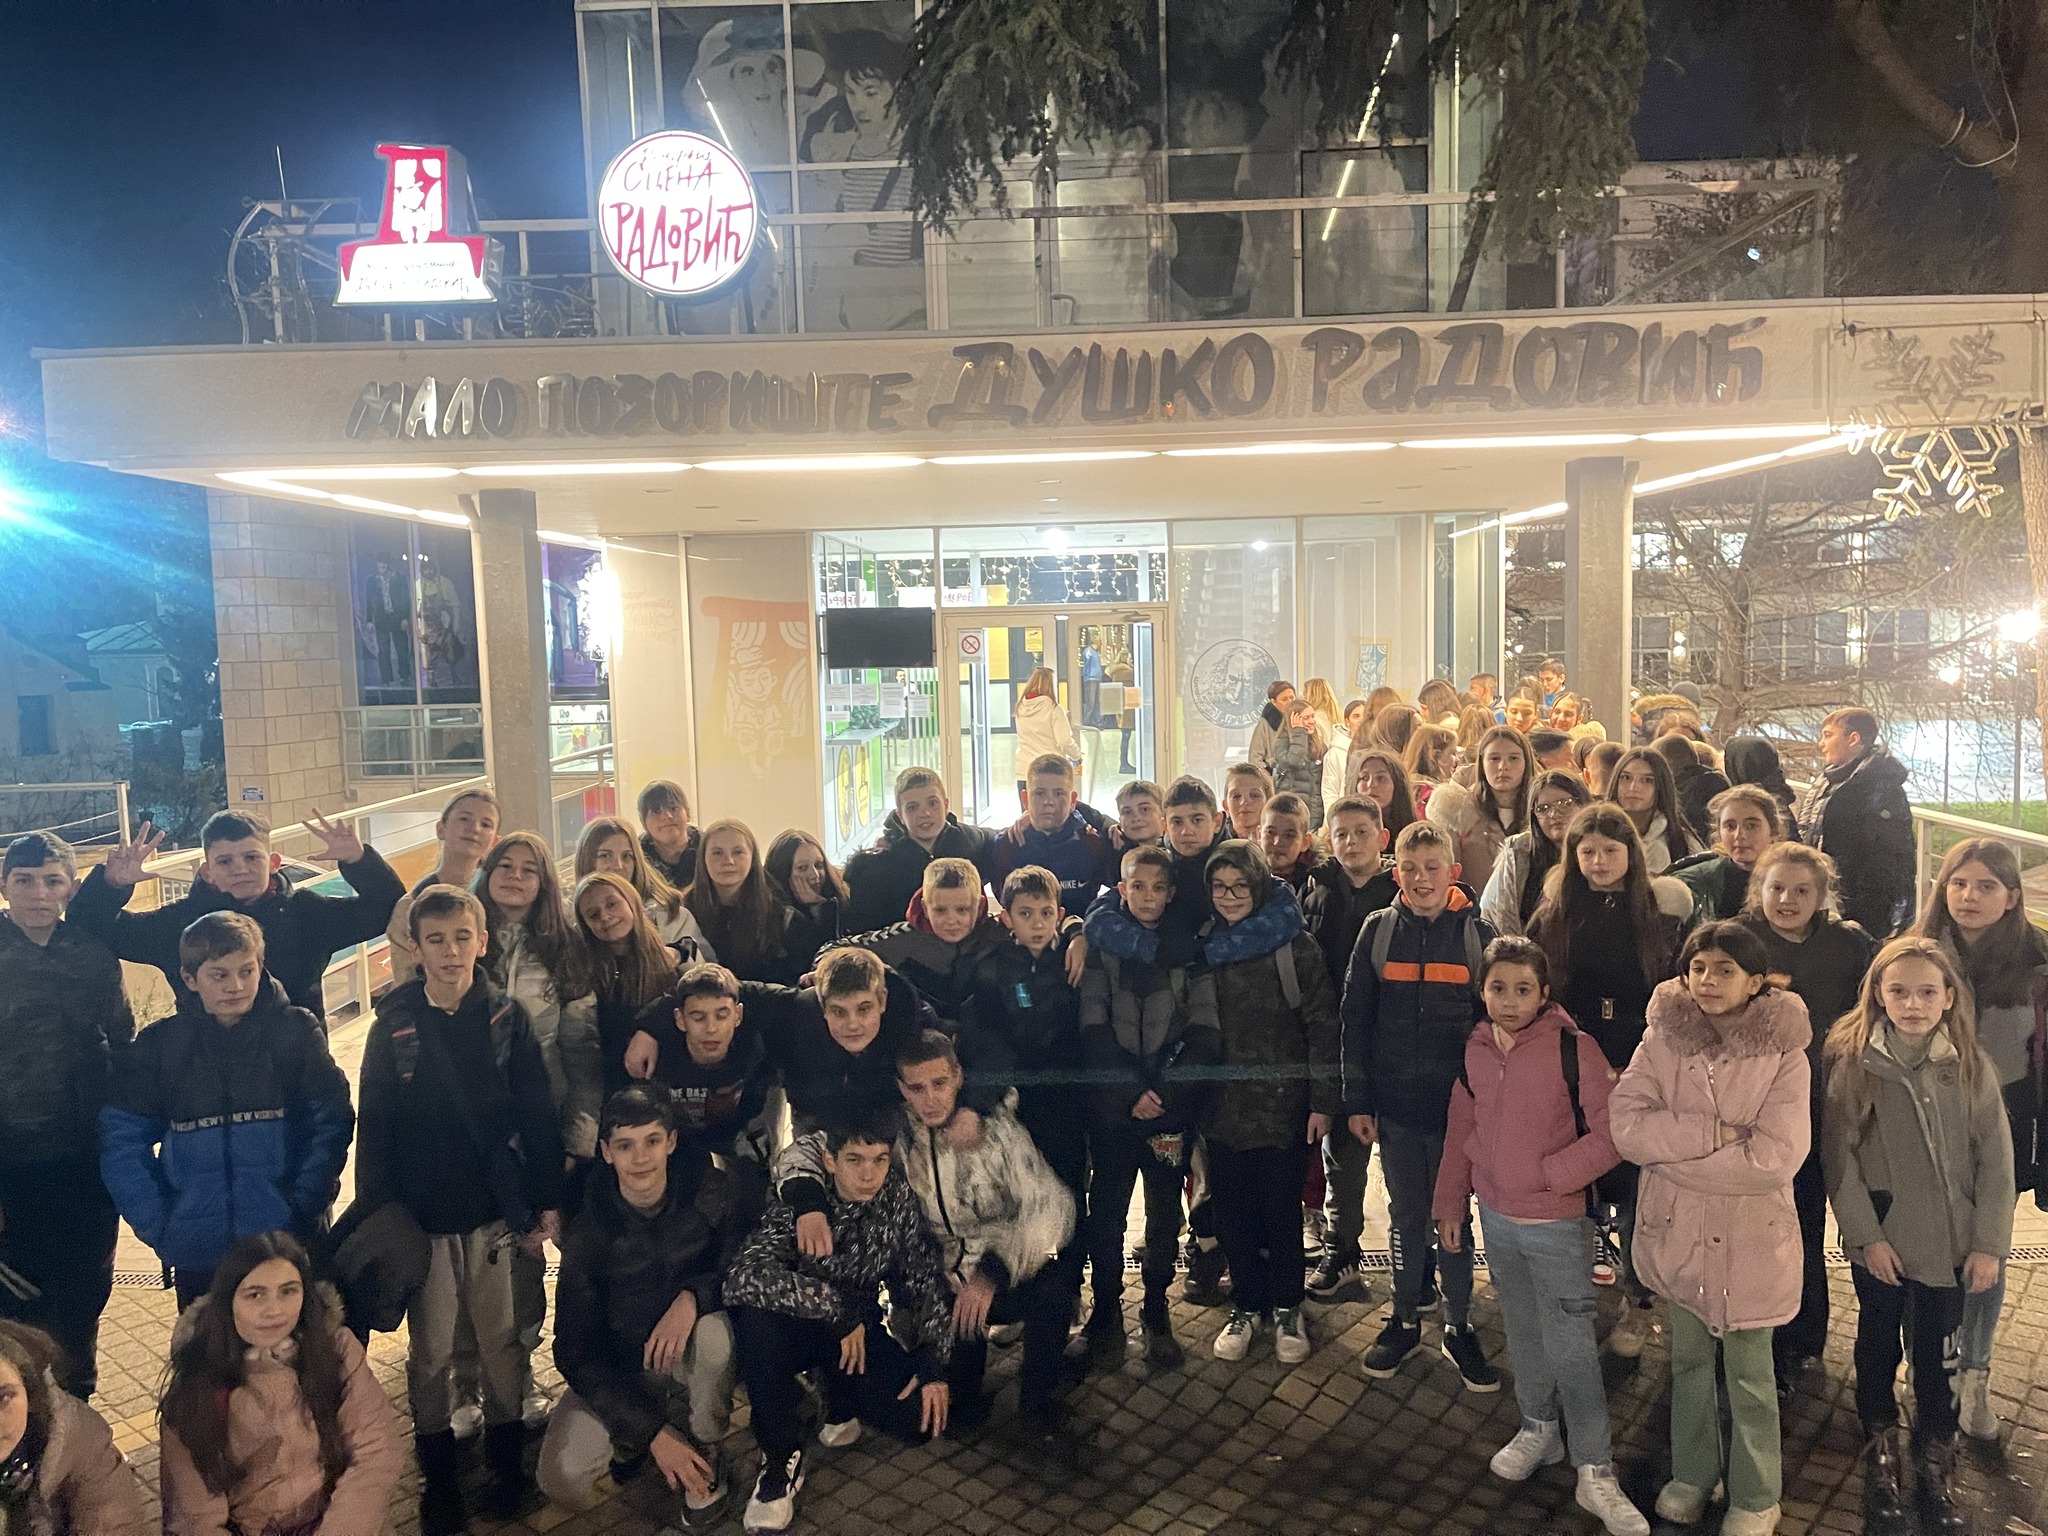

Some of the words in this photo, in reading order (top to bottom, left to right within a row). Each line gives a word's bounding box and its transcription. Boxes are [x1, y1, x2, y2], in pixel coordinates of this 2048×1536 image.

[609, 195, 753, 285] РАДОВИЋ
[345, 376, 518, 439] МАЛО
[537, 369, 914, 437] ПОЗОРИШТЕ
[927, 327, 1277, 429] ДУШКО
[1060, 880, 1077, 889] NIKE
